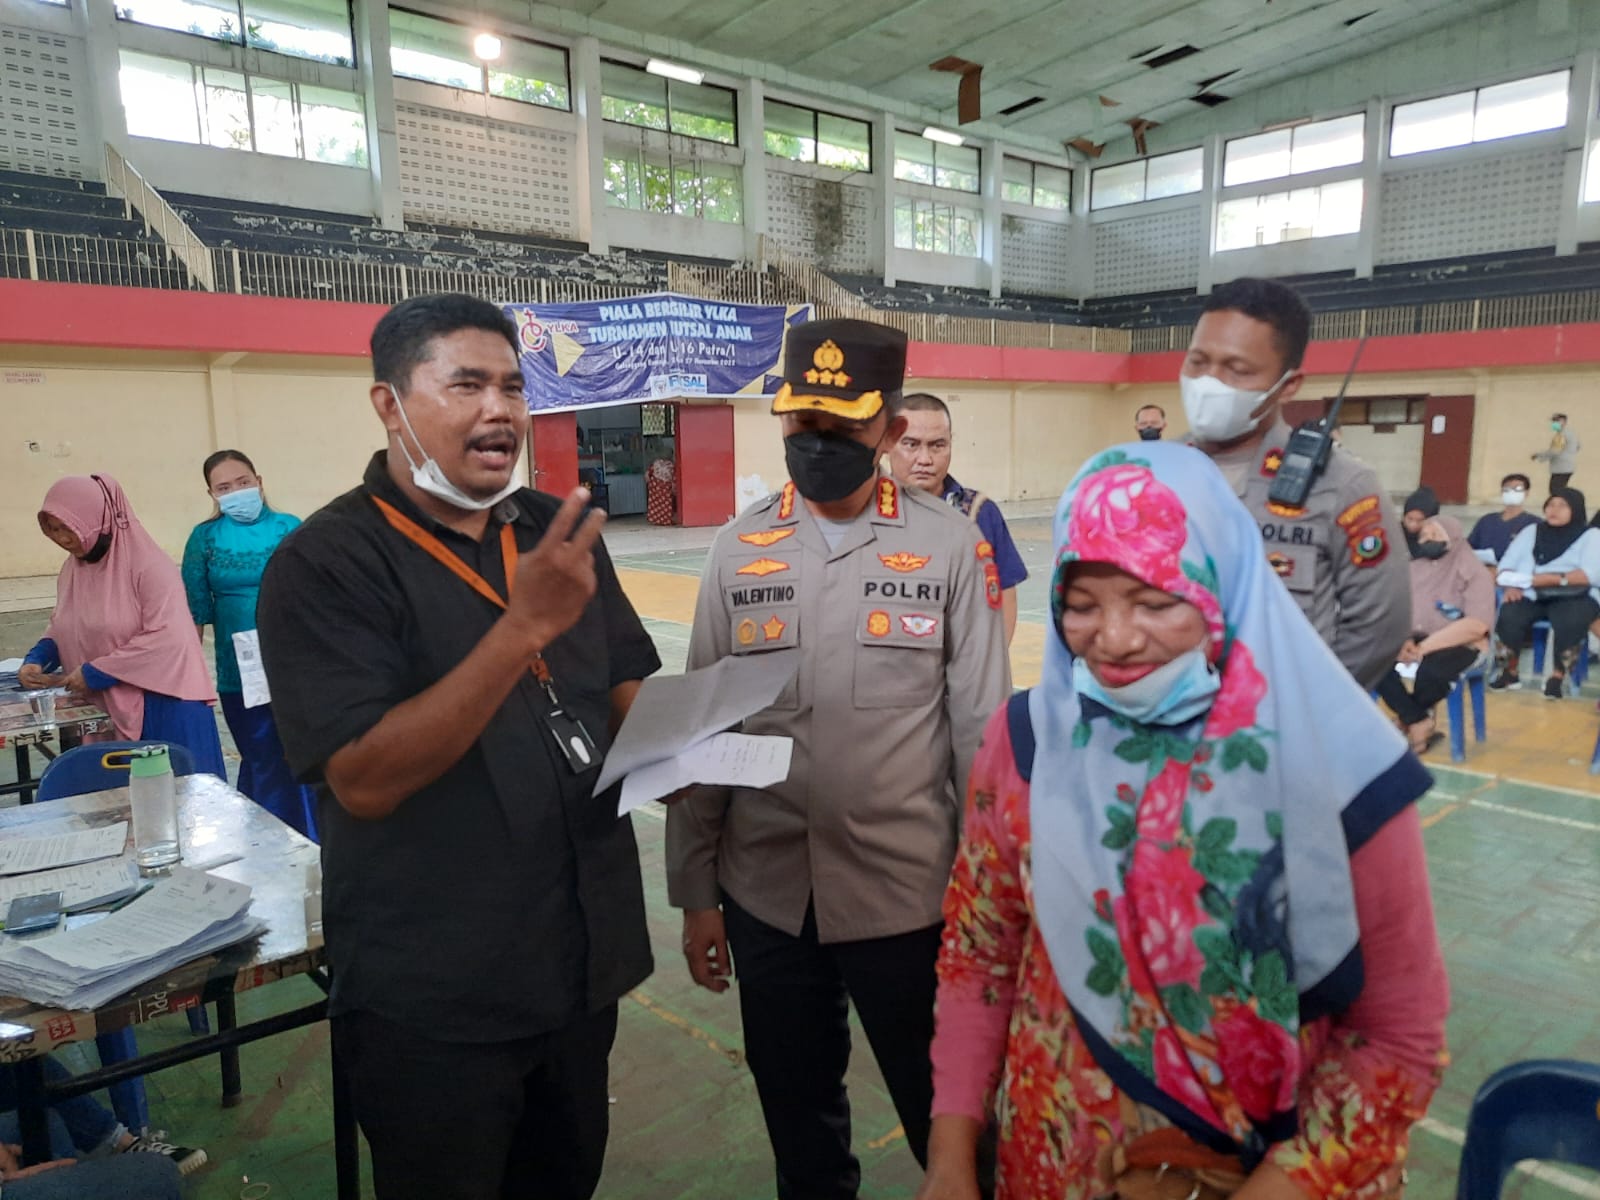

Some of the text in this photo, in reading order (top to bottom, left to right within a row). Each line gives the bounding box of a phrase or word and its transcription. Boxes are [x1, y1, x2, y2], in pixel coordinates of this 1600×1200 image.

[599, 304, 643, 321] PIALA
[704, 305, 737, 321] YLKA
[546, 322, 577, 333] YLKA
[588, 321, 667, 343] TURNAMEN
[716, 324, 752, 340] ANAK
[1261, 523, 1312, 544] OLRI
[731, 585, 794, 606] VALENTINO
[864, 581, 941, 601] POLRI
